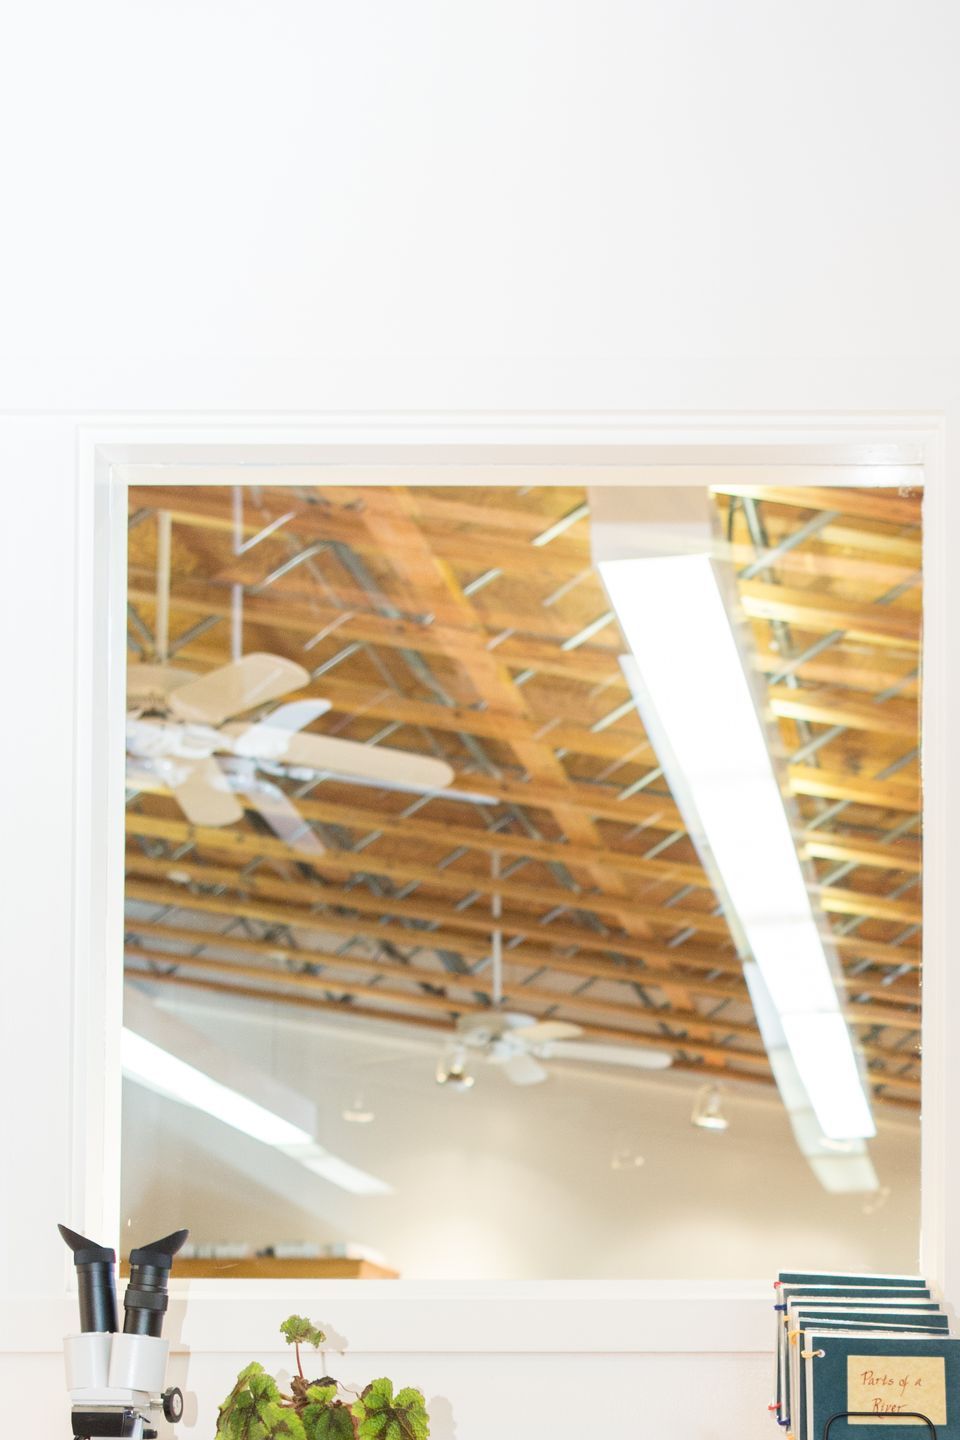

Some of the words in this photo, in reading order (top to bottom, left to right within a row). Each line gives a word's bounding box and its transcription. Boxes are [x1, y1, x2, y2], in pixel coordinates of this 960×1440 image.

[861, 1370, 894, 1386] Parts
[898, 1375, 910, 1398] of
[914, 1378, 922, 1387] a
[872, 1397, 908, 1420] River
